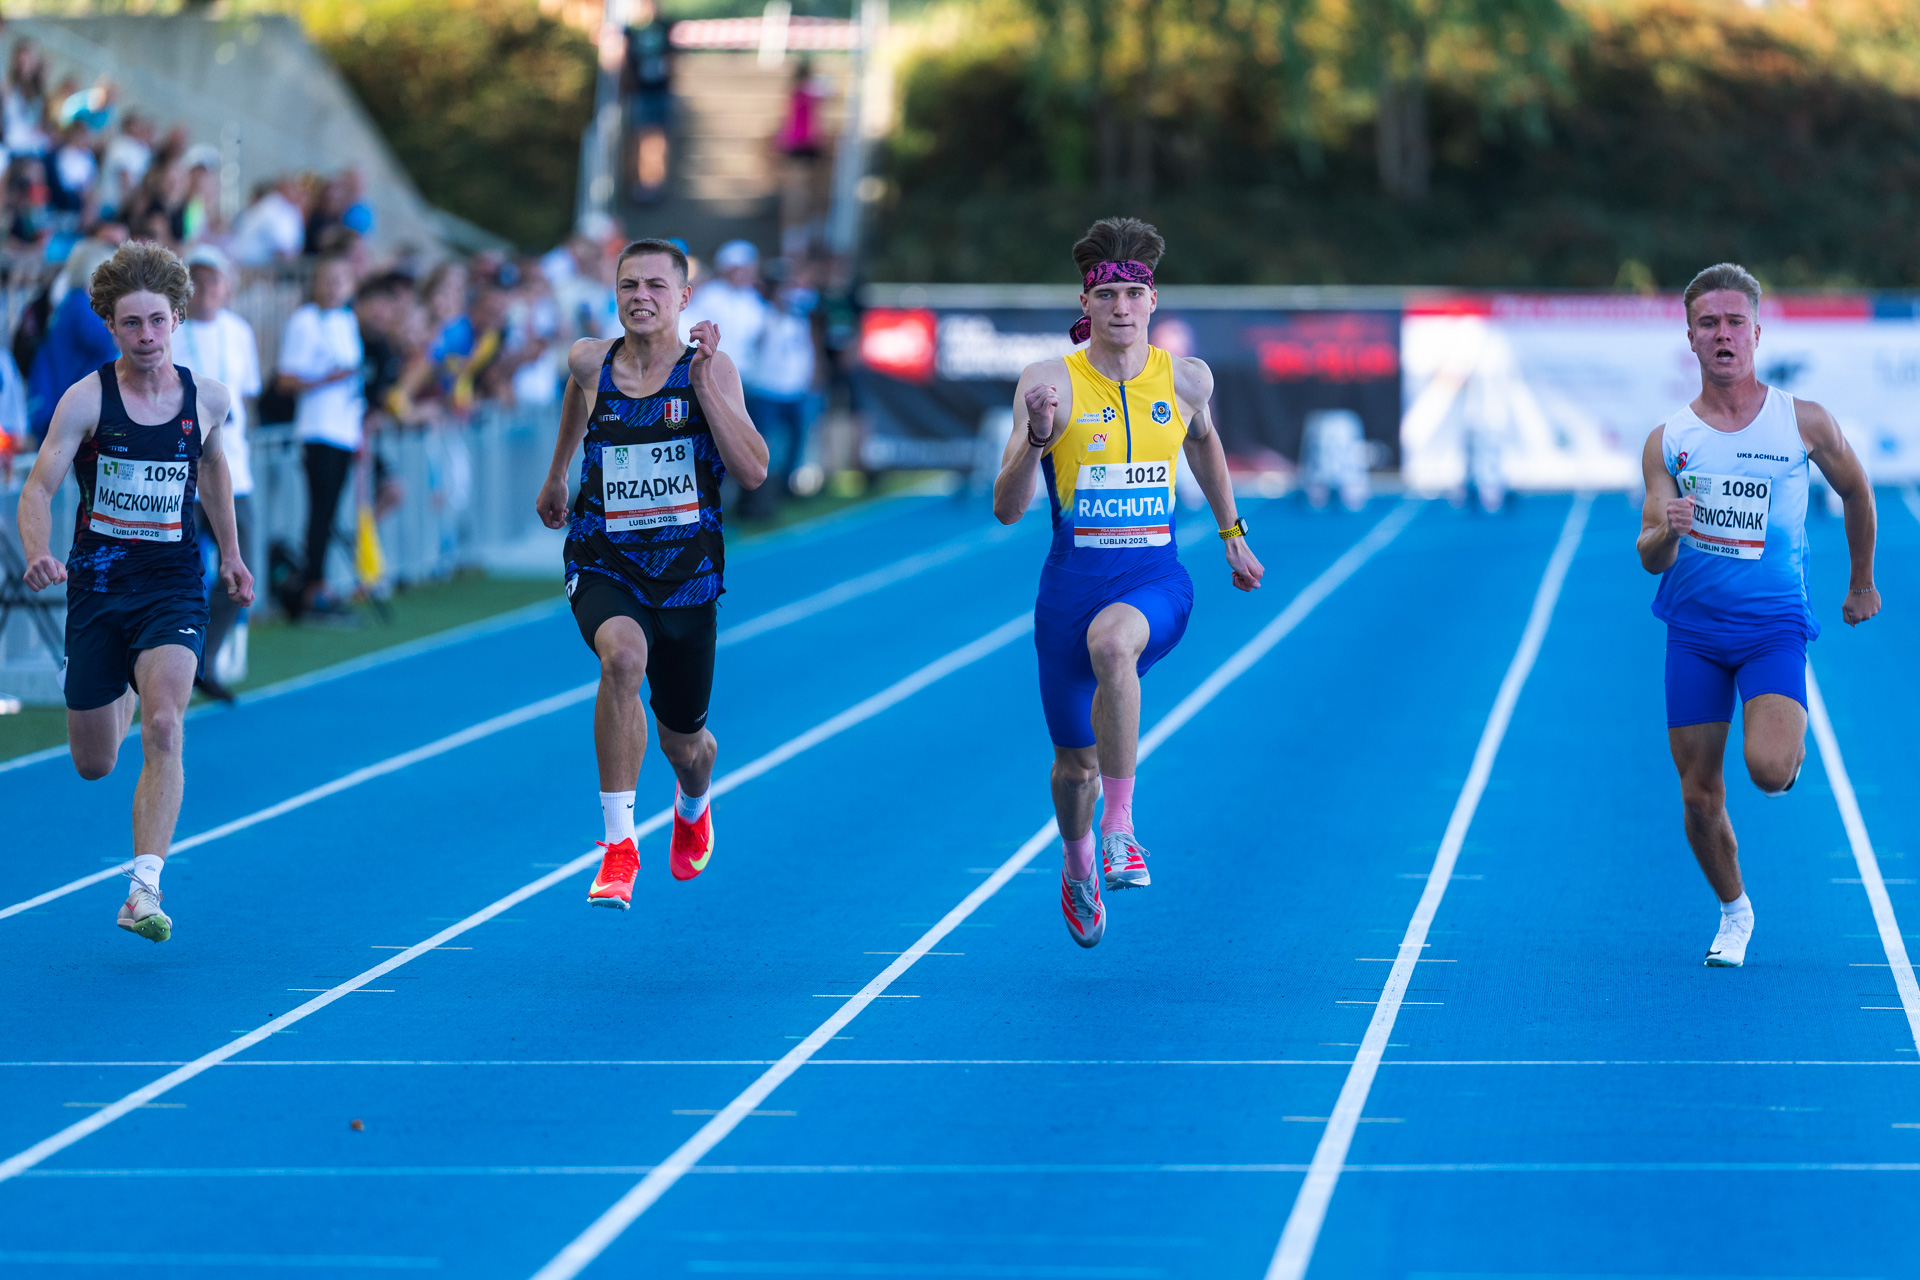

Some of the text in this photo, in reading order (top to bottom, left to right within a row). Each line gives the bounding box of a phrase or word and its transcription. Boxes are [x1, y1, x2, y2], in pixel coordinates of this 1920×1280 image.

[651, 444, 686, 464] 918
[1753, 453, 1790, 463] ACHILLES
[144, 465, 187, 482] 1096
[1125, 466, 1166, 484] 1012
[606, 474, 695, 501] PRZĄDKA
[1722, 480, 1768, 499] 1080
[98, 486, 182, 513] MĄCZKOWIAK
[1078, 497, 1165, 518] RACHUTA
[628, 515, 678, 527] LUBLIN 2025
[112, 527, 160, 538] LUBLIN 2025
[1128, 537, 1148, 545] 2025
[1696, 541, 1740, 555] LUBLIN 2025
